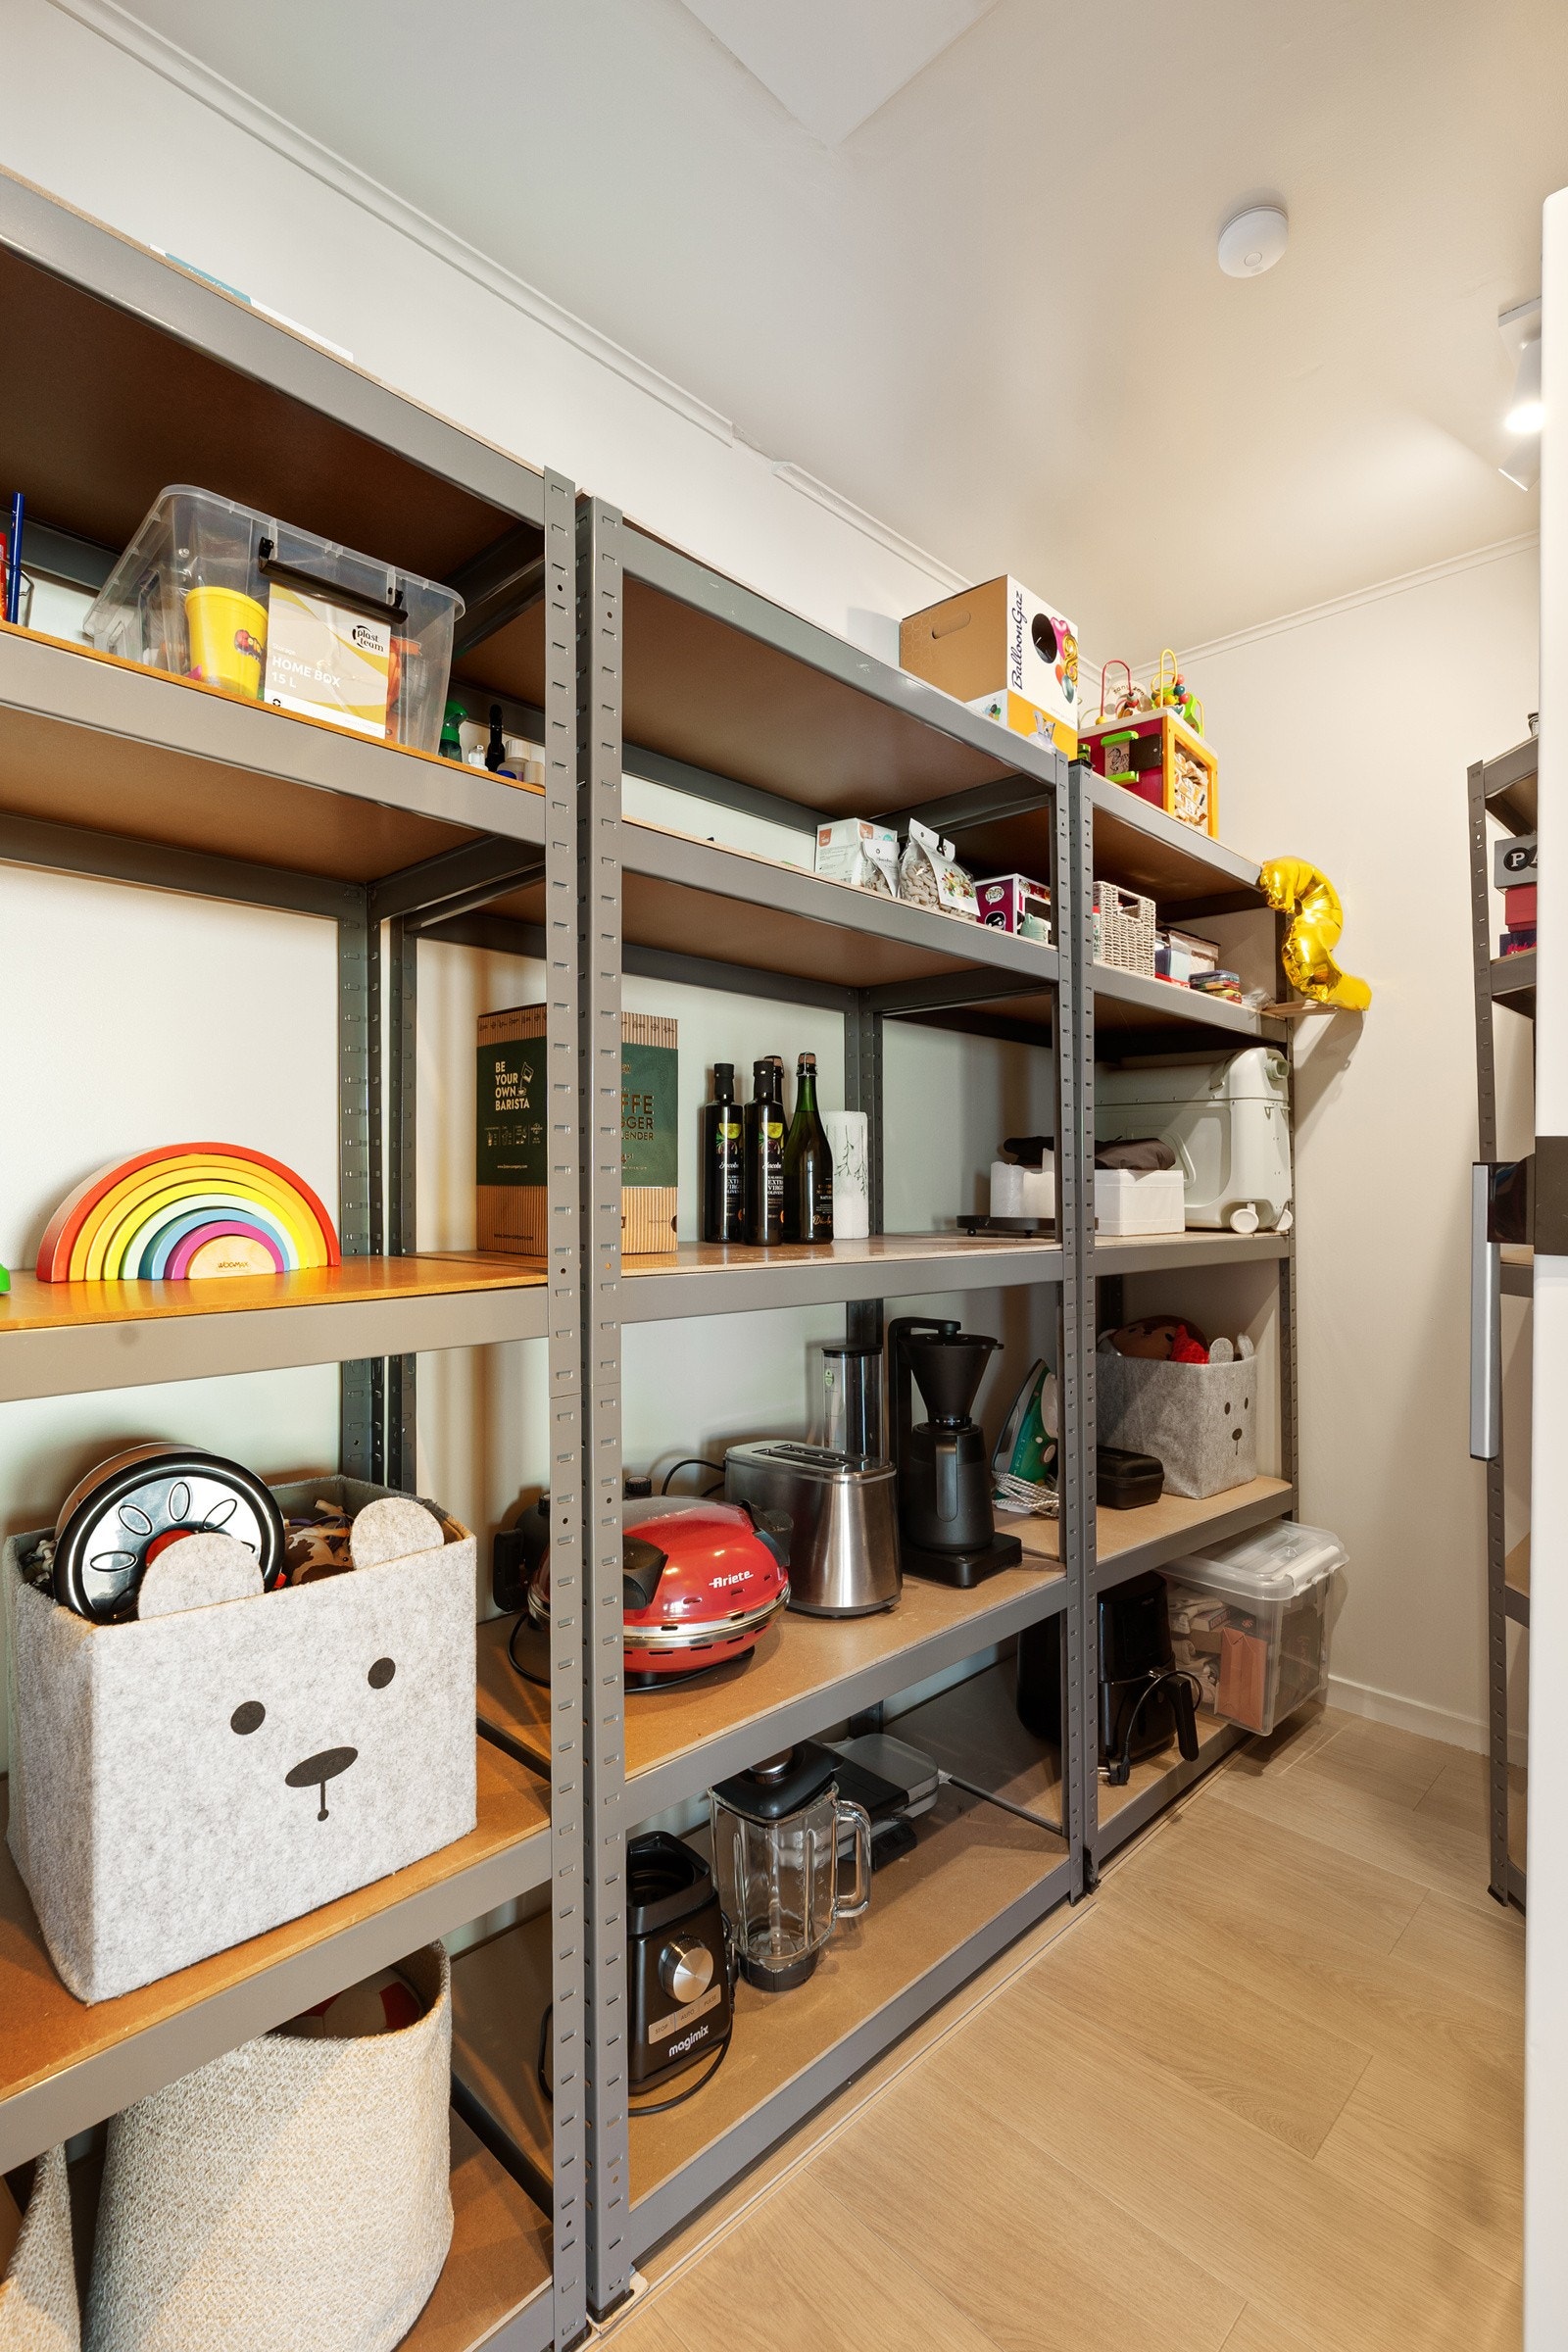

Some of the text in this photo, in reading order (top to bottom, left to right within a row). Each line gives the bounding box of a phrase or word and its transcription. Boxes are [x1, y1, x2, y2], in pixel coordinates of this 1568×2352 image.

[357, 628, 379, 643] plast
[1010, 590, 1028, 690] BalloonGaz
[360, 638, 384, 653] team
[271, 656, 342, 688] HOME BOX
[271, 671, 297, 689] 15 L
[495, 1061, 506, 1073] BE
[495, 1073, 518, 1086] YOUR
[495, 1086, 516, 1099] OWN
[495, 1098, 530, 1111] BARISTA
[621, 1094, 655, 1115] FFE
[709, 1570, 754, 1589] Ariete
[680, 2008, 695, 2021] AUTO
[668, 2025, 710, 2057] magimix
